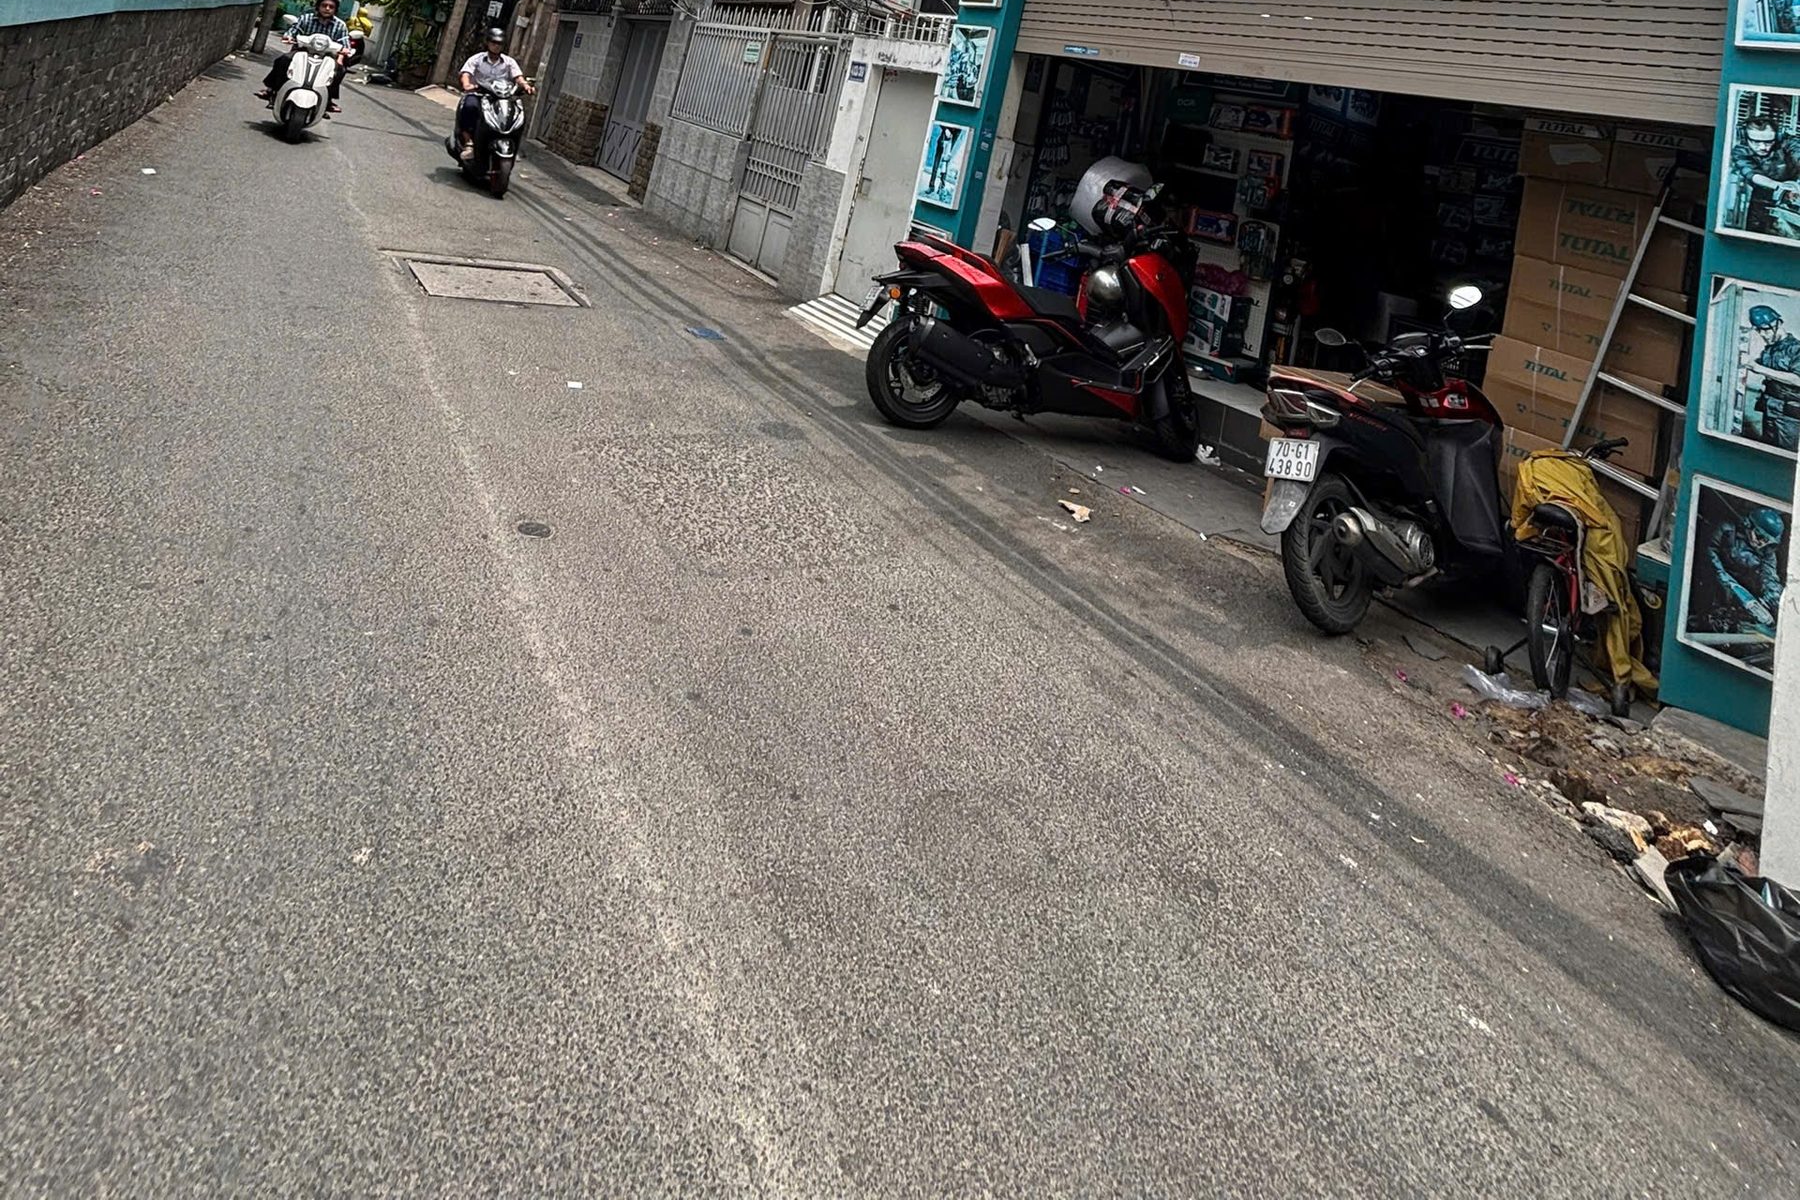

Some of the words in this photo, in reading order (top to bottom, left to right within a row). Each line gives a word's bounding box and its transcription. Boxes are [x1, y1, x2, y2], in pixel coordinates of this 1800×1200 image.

[1537, 120, 1586, 136] TOTAL
[1632, 132, 1685, 148] TOTAL
[1559, 232, 1631, 261] TOTAL
[1548, 278, 1592, 298] TOTAL
[1524, 359, 1569, 382] TOTAL
